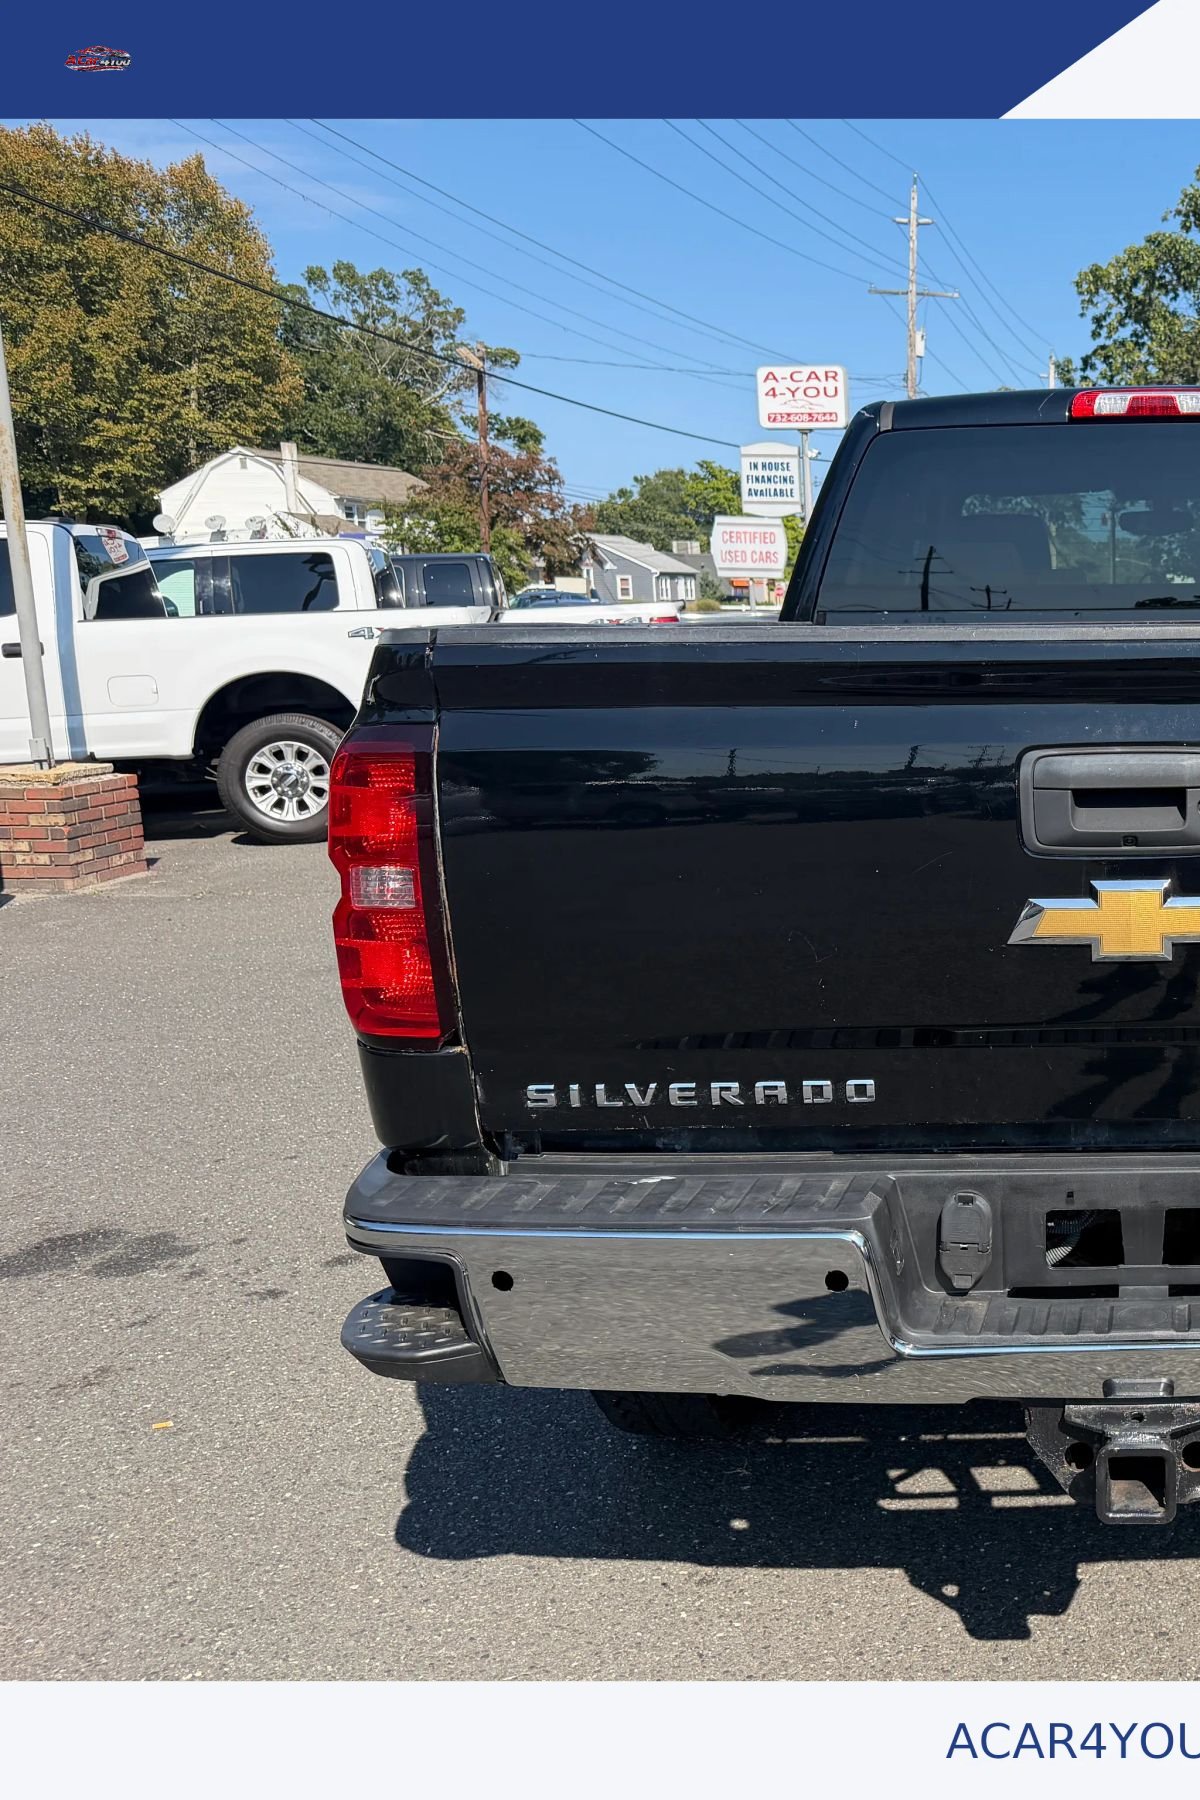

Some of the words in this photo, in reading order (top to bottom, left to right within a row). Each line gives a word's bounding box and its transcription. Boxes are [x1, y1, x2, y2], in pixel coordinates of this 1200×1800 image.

[763, 371, 839, 383] A-CAR
[764, 386, 838, 398] 4-YOU
[769, 414, 836, 422] 732-608-7644
[749, 461, 759, 471] IN
[761, 461, 791, 472] HOUSE
[746, 475, 794, 485] FINANCING
[722, 531, 776, 544] CERTIFIED
[720, 549, 748, 564] USED
[750, 550, 779, 564] CARS
[526, 1080, 876, 1108] SILVERADO
